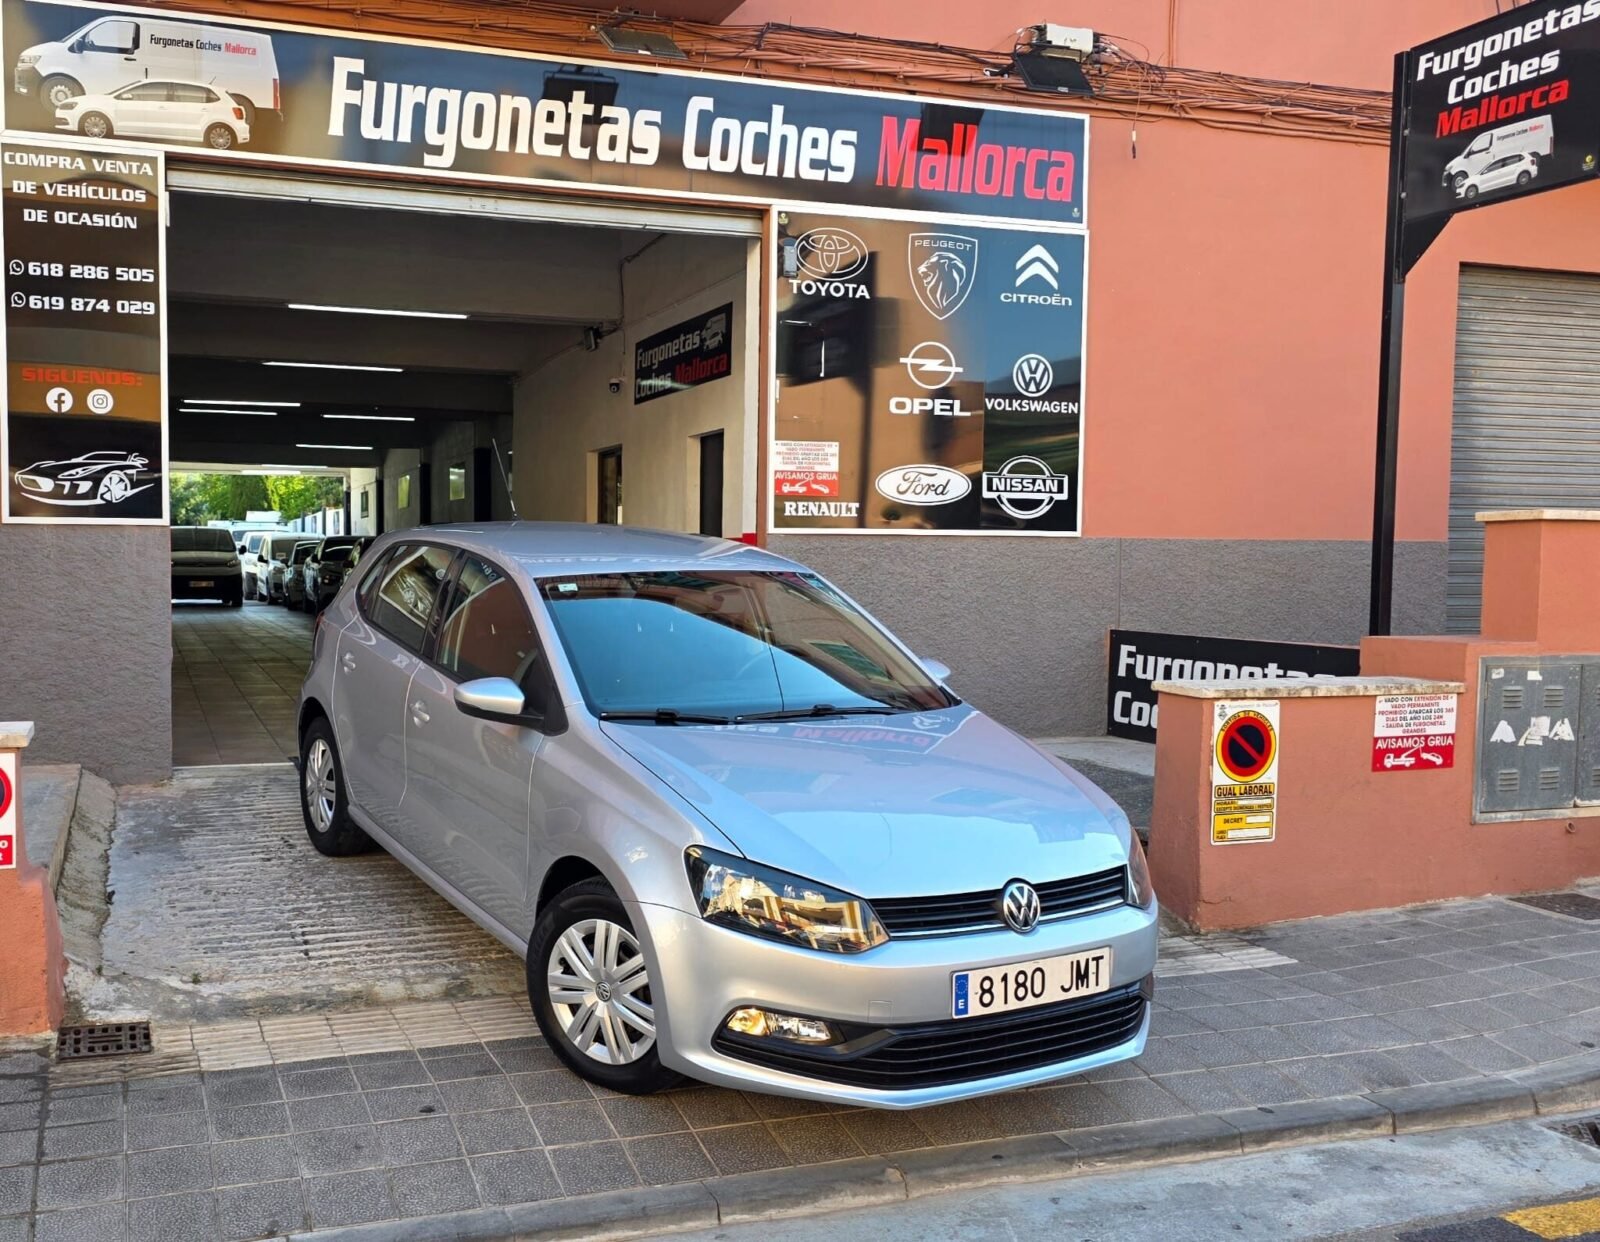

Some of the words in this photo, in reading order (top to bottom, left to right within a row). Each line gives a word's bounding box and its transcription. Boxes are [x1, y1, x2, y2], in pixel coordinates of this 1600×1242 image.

[150, 34, 194, 49] Furgonetas
[195, 39, 222, 52] Coches
[224, 43, 257, 56] Mallorca
[1416, 0, 1600, 81] Furgonetas
[1447, 50, 1561, 104] Coches
[1436, 79, 1570, 139] Mallorca
[328, 56, 662, 168] Furgonetas
[682, 95, 857, 184] Coches
[874, 115, 1075, 202] Mallorca
[4, 151, 87, 171] COMPRA
[92, 158, 154, 176] VENTA
[12, 180, 37, 194] DE
[43, 182, 147, 203] VEHÍCULOS
[23, 208, 48, 223] DE
[54, 210, 138, 230] OCASIÓN
[914, 239, 972, 251] PEUGEOT
[28, 261, 64, 277] 618
[70, 264, 109, 280] 286
[115, 267, 155, 283] 505
[789, 279, 871, 299] TOYOTA
[28, 295, 64, 311] 619
[71, 297, 110, 313] 874
[116, 300, 155, 315] 029
[637, 330, 701, 370] Furgonetas
[636, 372, 672, 399] Coches
[674, 353, 728, 384] Mallorca
[889, 396, 972, 416] OPEL
[985, 398, 1079, 414] VOLKSWAGEN
[775, 471, 814, 481] AVISAMOS
[816, 472, 838, 481] GRUA
[896, 470, 950, 497] Ford
[992, 477, 1059, 494] NISSAN
[784, 501, 860, 517] RENAULT
[1376, 736, 1425, 750] AVISAMOS
[1427, 736, 1454, 747] GRUA
[1216, 786, 1237, 798] GUAL
[1239, 784, 1273, 796] LABORAL
[979, 966, 1046, 1008] 8180
[1060, 955, 1105, 993] JMT
[958, 999, 966, 1009] E
